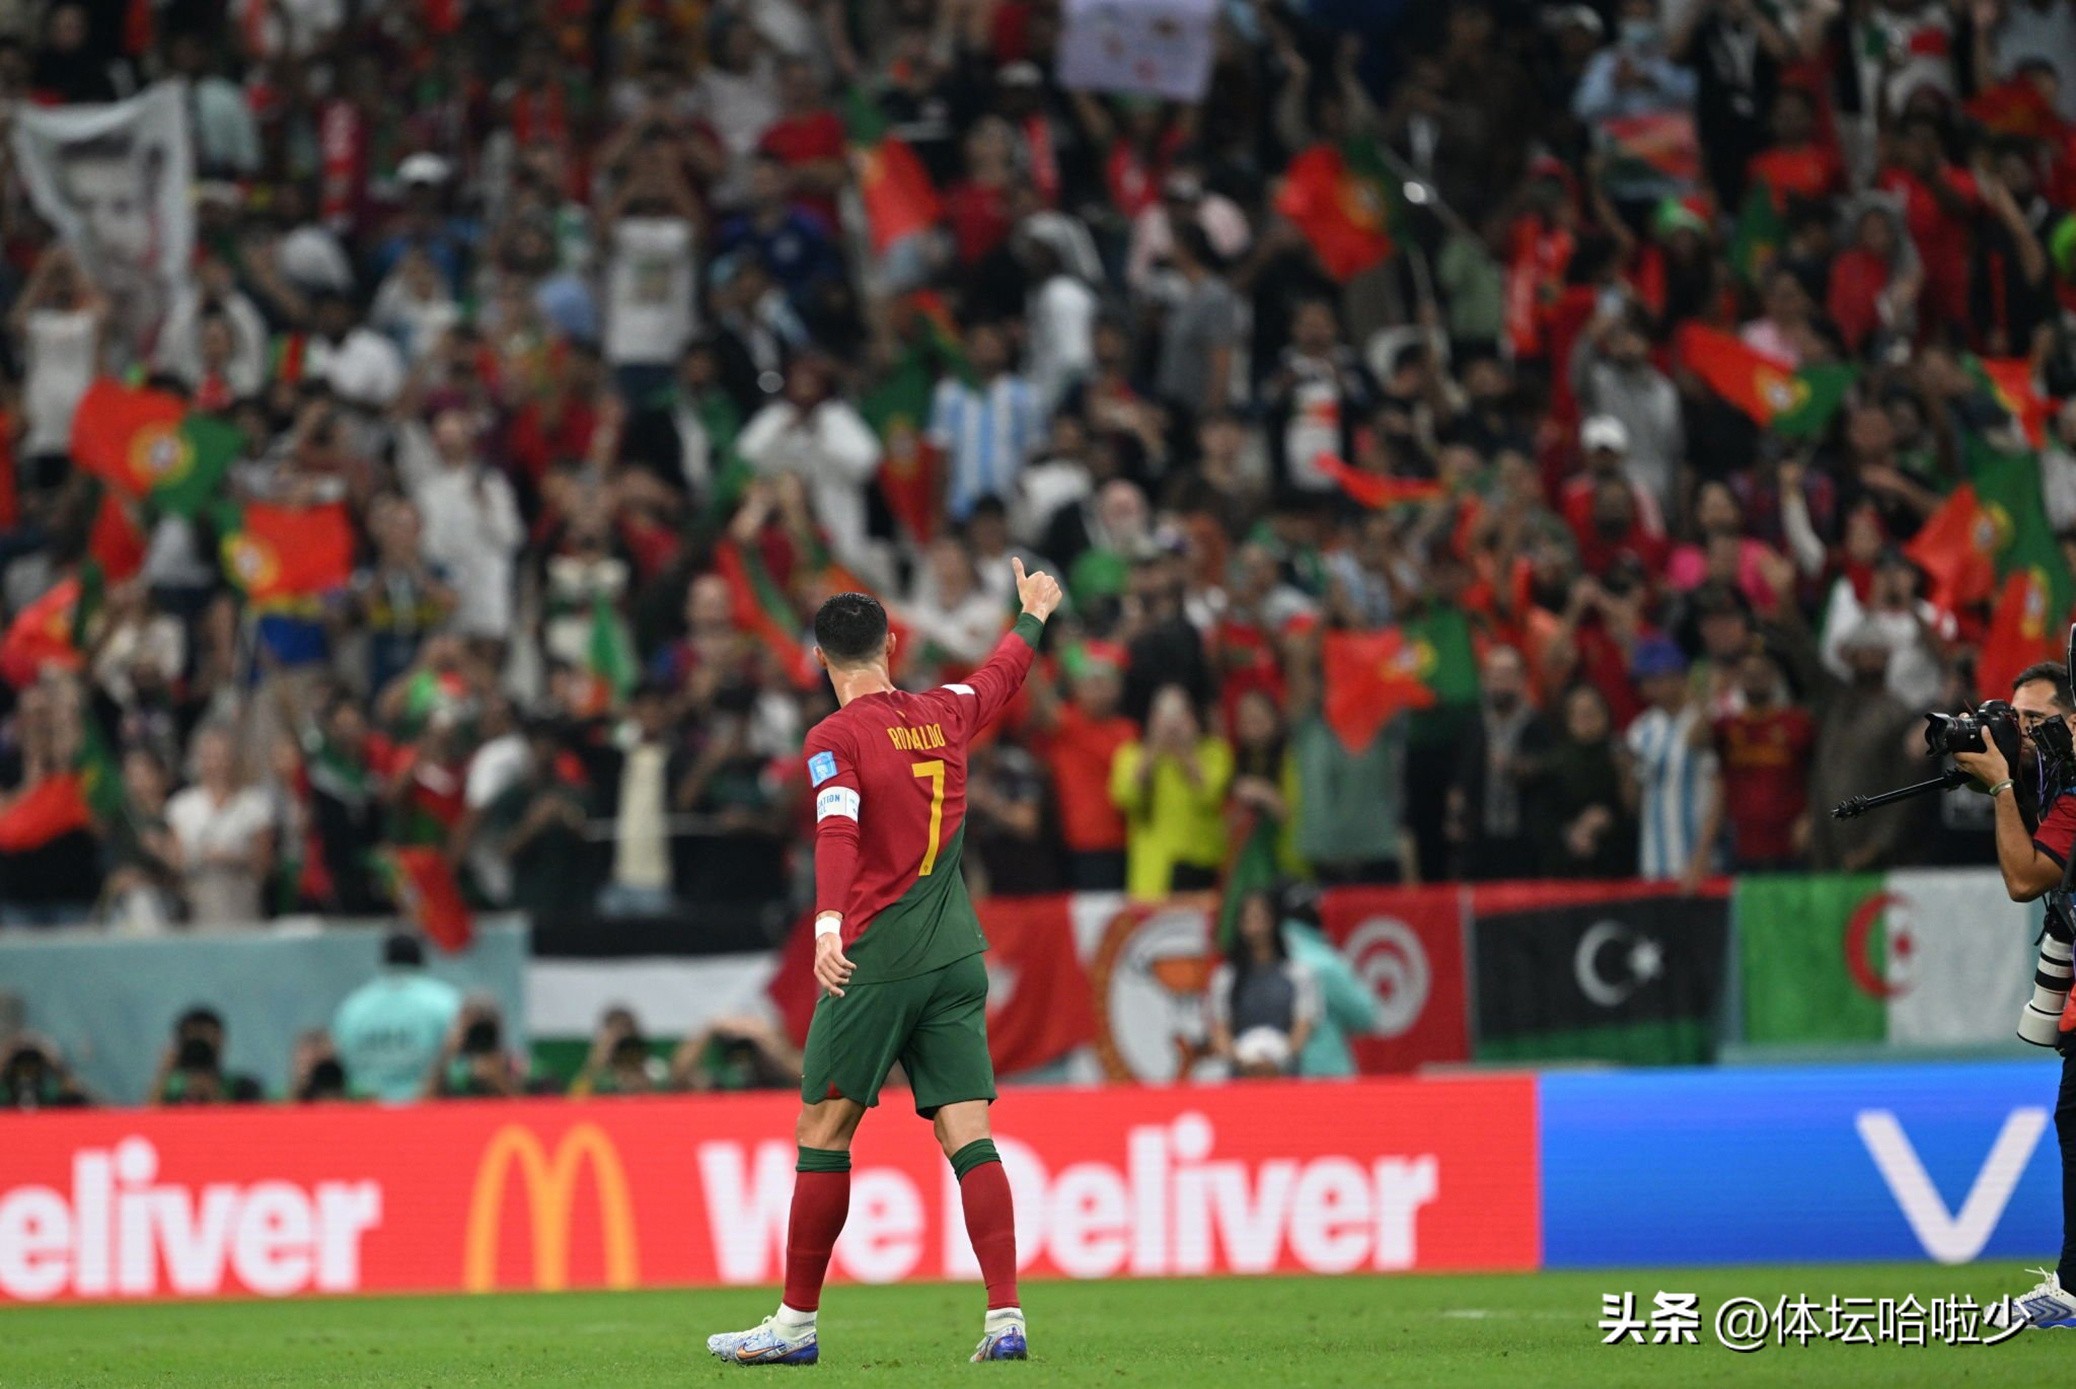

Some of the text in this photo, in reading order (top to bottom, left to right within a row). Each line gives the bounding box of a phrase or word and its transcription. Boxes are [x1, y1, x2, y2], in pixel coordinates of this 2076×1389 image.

[886, 723, 946, 750] RONALDO
[911, 759, 945, 876] 7
[0, 1134, 383, 1299] eliver
[696, 1111, 1437, 1284] We Deliver
